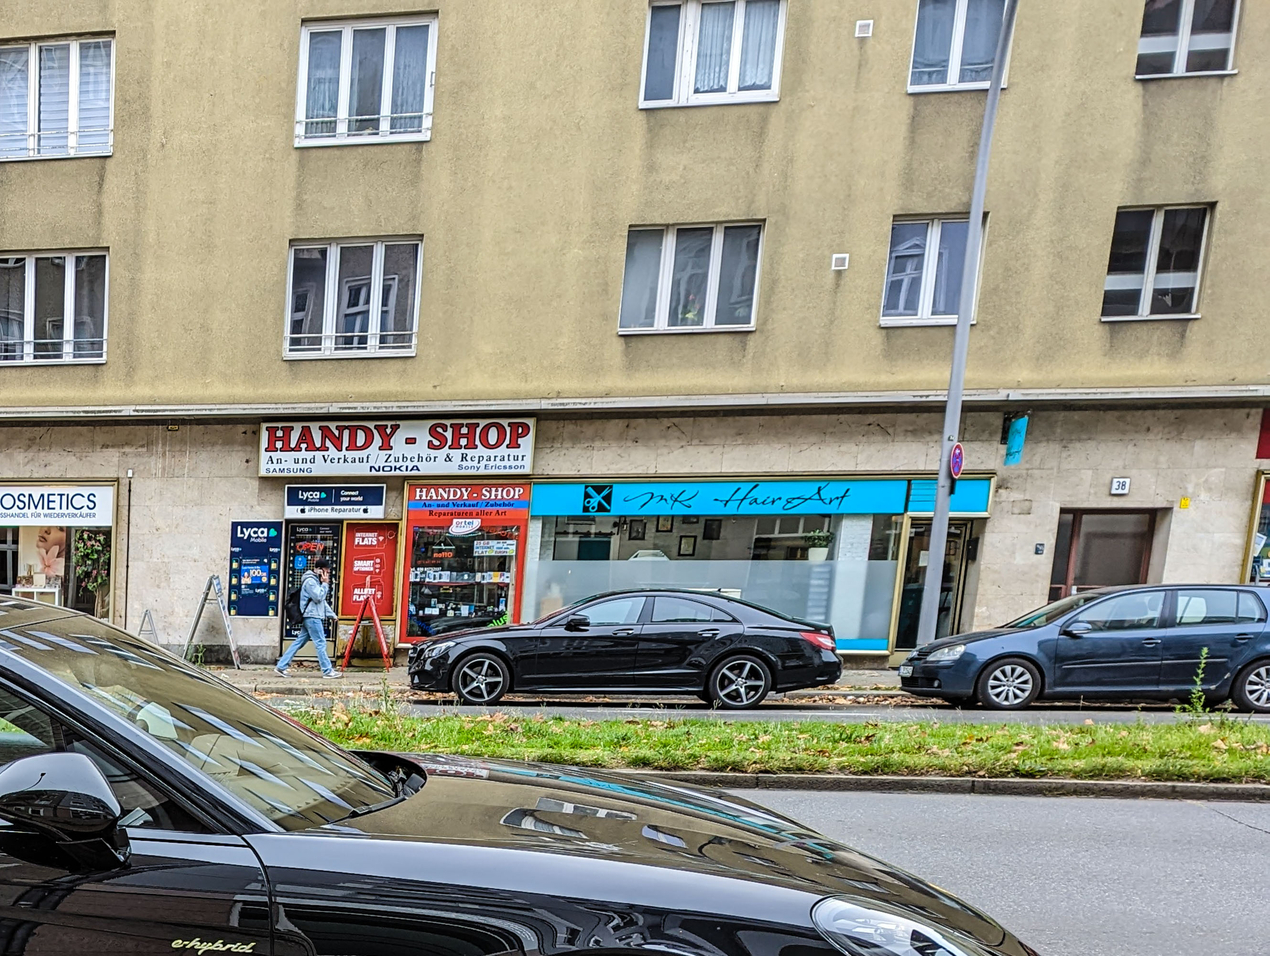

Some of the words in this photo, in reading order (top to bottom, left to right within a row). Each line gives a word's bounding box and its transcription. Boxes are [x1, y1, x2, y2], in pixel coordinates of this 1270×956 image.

[264, 424, 400, 452] HANDY
[427, 422, 530, 450] SHOP
[266, 455, 288, 465] An-
[293, 454, 316, 465] und
[322, 453, 371, 464] Verkauf
[384, 452, 438, 463] Zubehör
[444, 453, 454, 463] &
[460, 452, 526, 465] Reparatur
[369, 465, 421, 473] NOKIA
[457, 463, 481, 471] Sony
[484, 463, 525, 471] Ericsson
[1114, 480, 1127, 490] 38
[298, 490, 319, 500] Lyca
[415, 488, 471, 500] HANDY
[481, 487, 523, 499] SHOP
[714, 483, 782, 512] Hair
[782, 482, 851, 511] Art
[237, 526, 268, 540] Lyca
[296, 541, 325, 552] OPEN
[355, 537, 377, 545] FLATS
[171, 937, 257, 956] e-hybrid
